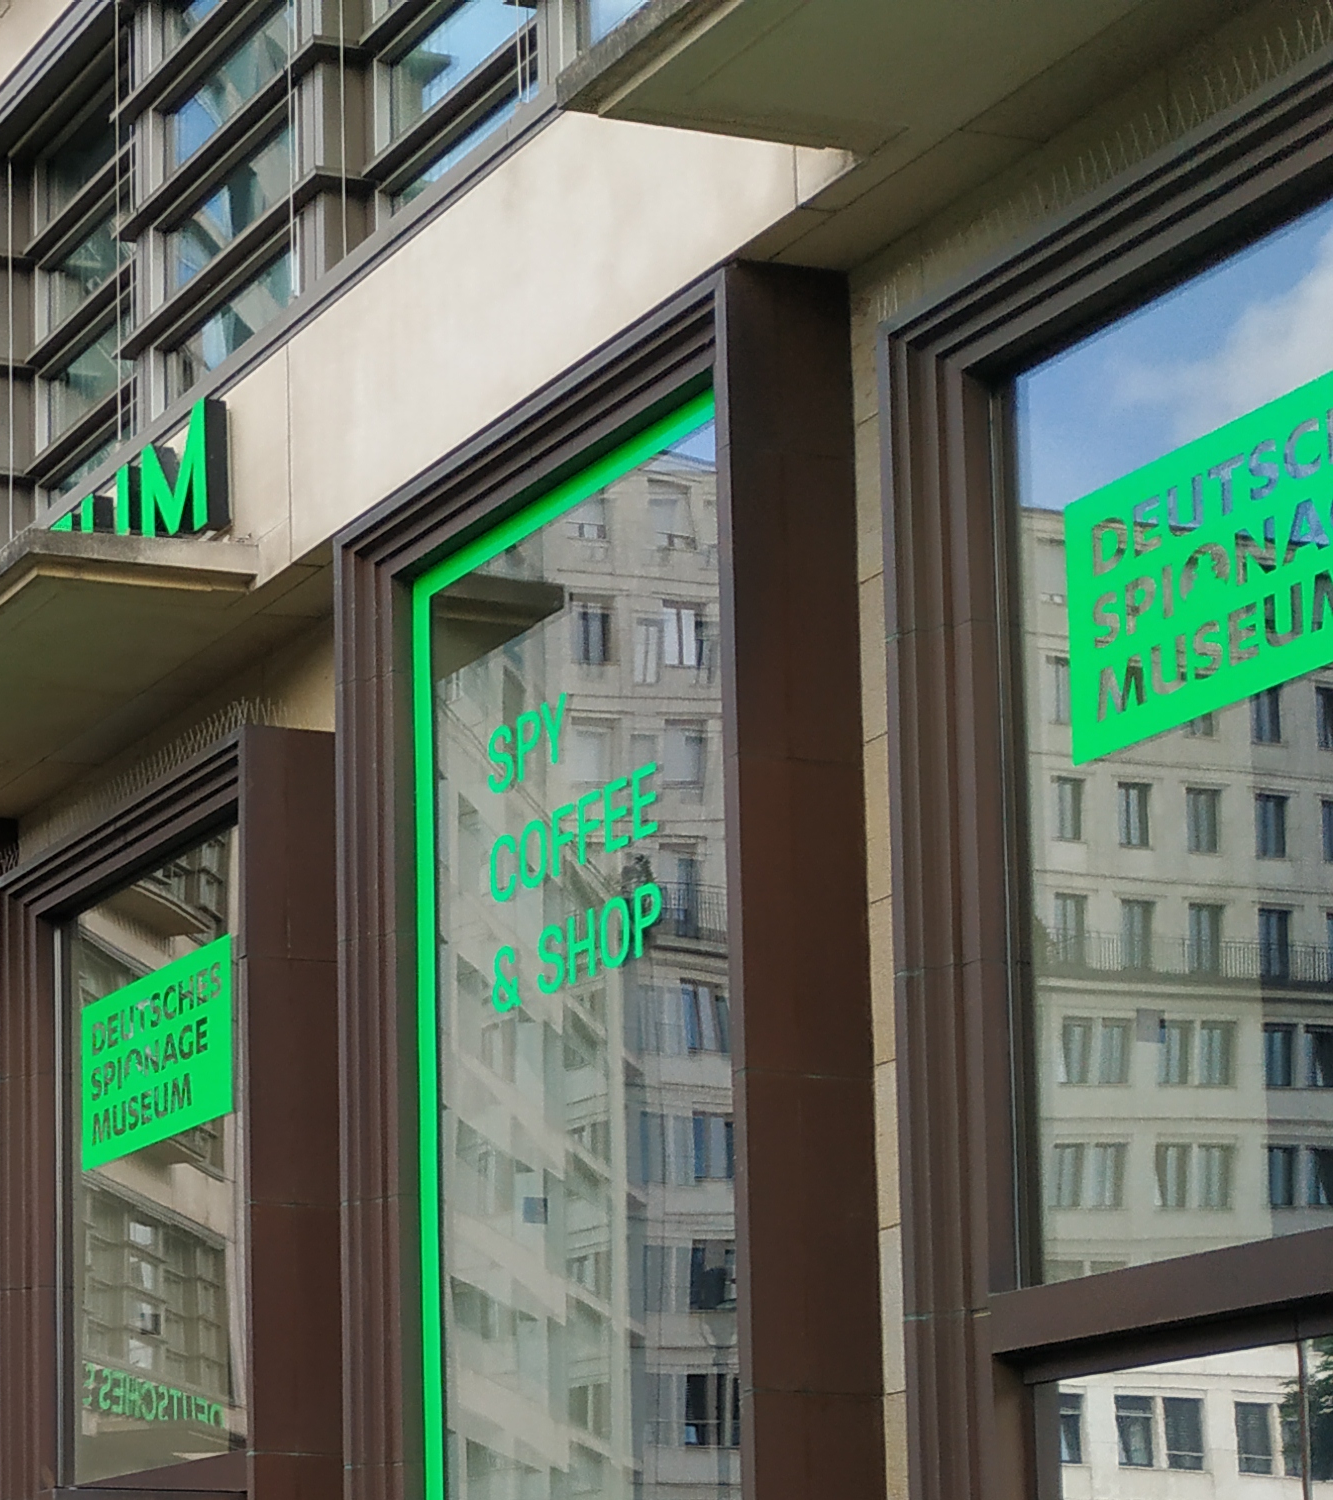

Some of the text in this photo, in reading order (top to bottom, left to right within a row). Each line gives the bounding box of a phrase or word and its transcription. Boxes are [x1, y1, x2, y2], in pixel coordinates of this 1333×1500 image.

[1092, 408, 1333, 577] DEUTSC
[1093, 498, 1333, 650] SPIONA
[487, 692, 567, 793] SPY
[490, 761, 658, 902] COFFEE
[492, 882, 662, 1013] & SHOP
[91, 1016, 208, 1101] SPIONAGE
[92, 962, 222, 1056] DEUTSCHES
[92, 1073, 192, 1146] MUSEUM
